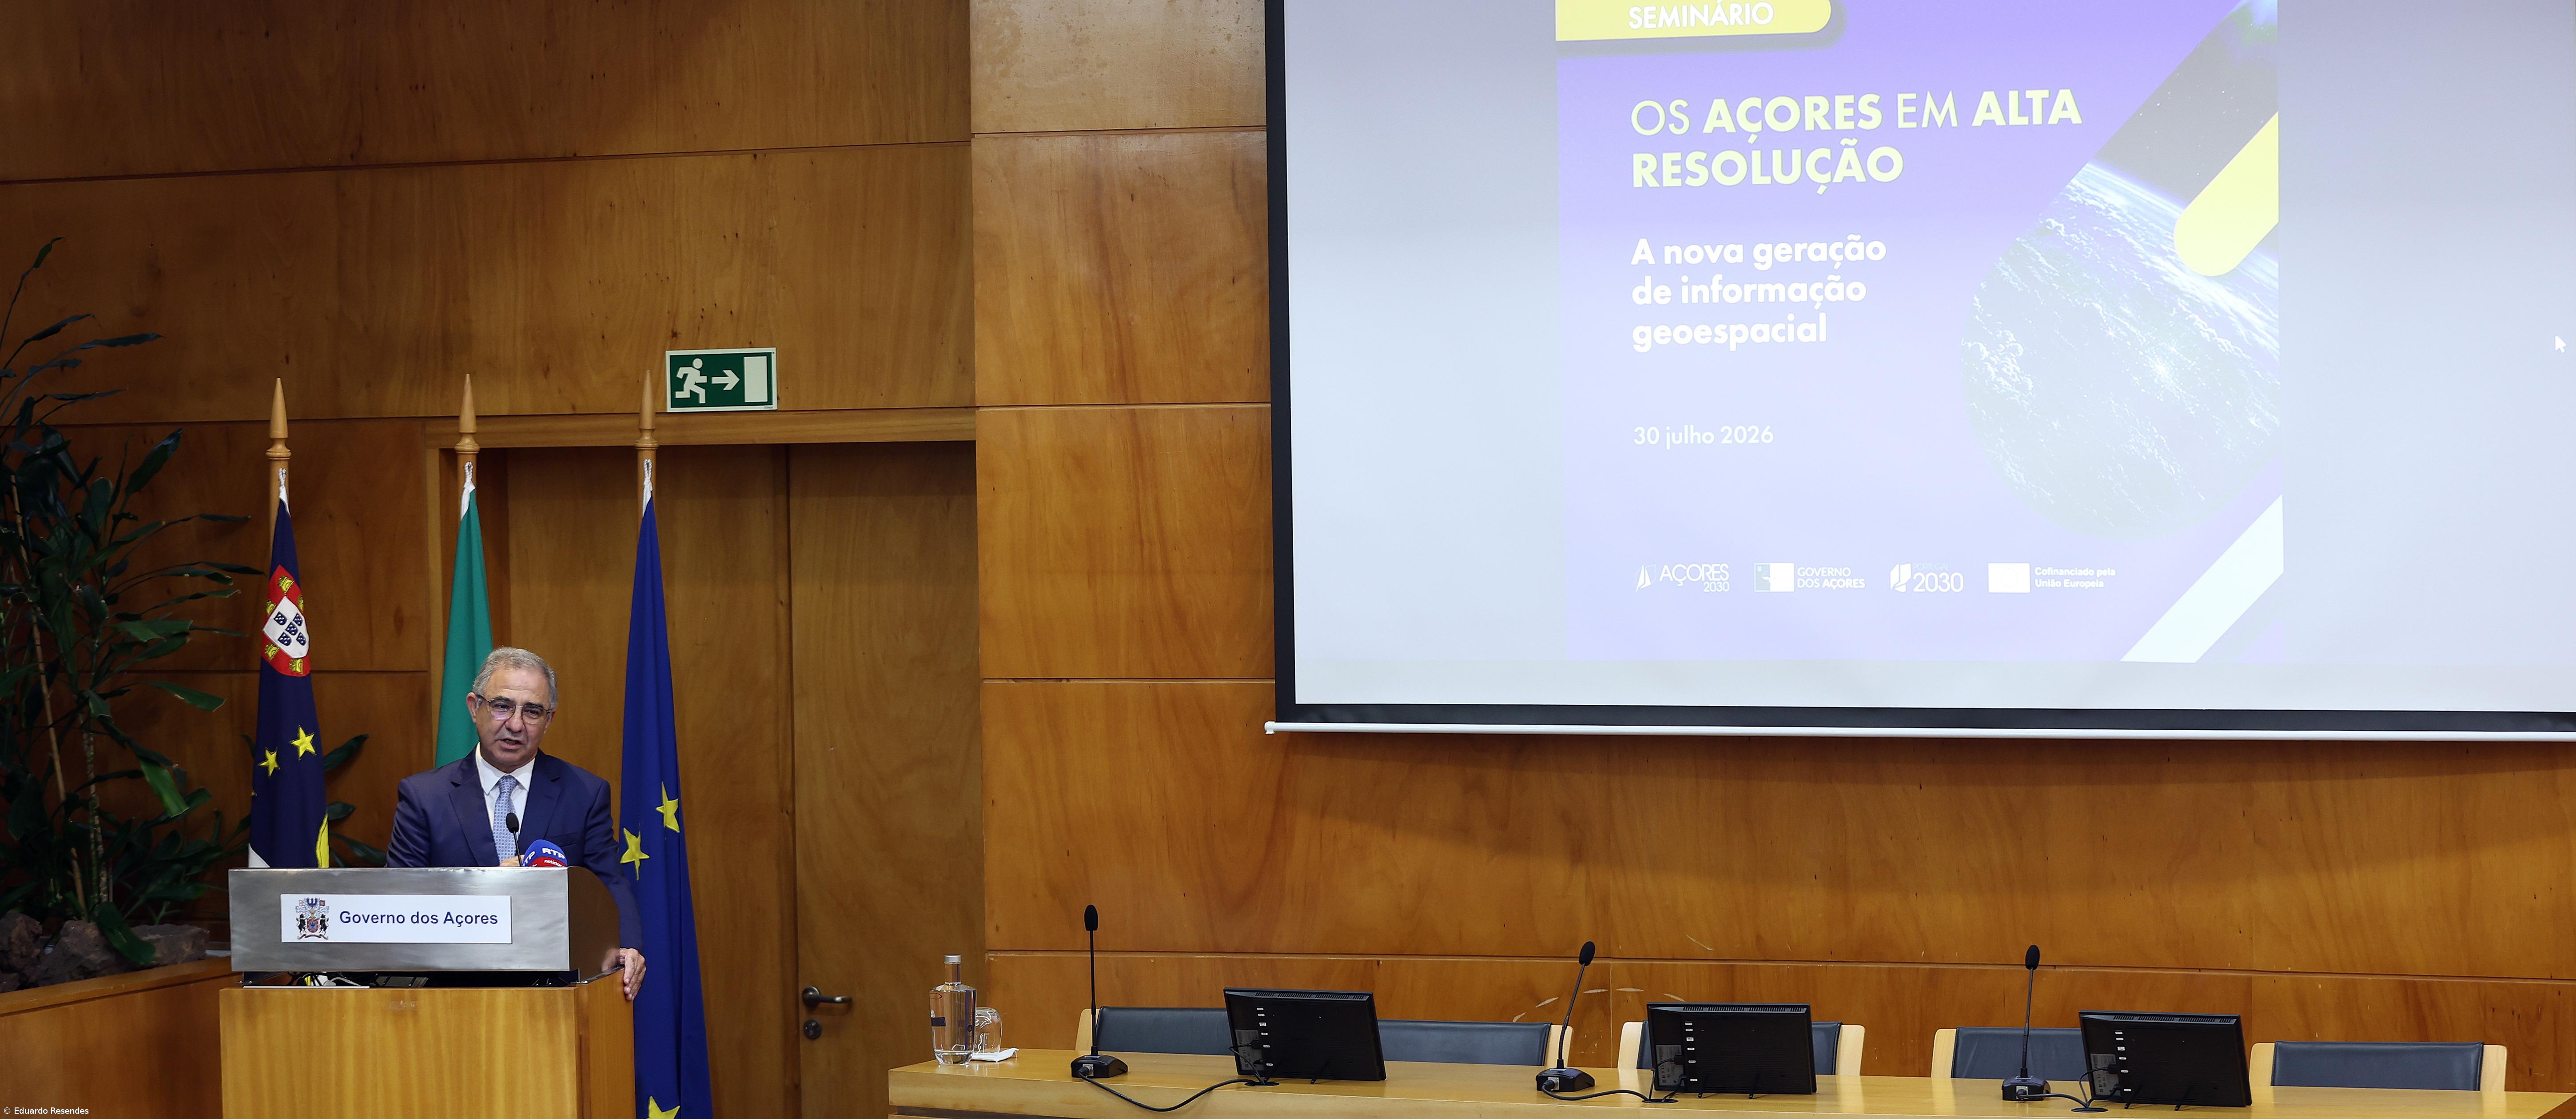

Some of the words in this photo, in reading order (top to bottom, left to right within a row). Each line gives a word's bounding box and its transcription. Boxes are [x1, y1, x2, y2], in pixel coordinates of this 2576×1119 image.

[1629, 0, 1773, 29] SEMINÁRIO
[1632, 100, 1689, 135] OS
[1703, 94, 1882, 144] AÇORES
[1898, 91, 1957, 128] EM
[1972, 89, 2082, 126] ALTA
[1633, 138, 1903, 194] RESOLUÇÃO
[1631, 239, 1655, 264] A
[1664, 244, 1743, 264] nova
[1753, 234, 1886, 270] geração
[1632, 276, 1672, 304] de
[1681, 274, 1866, 310] informação
[1633, 313, 1826, 352] geoespacial
[1634, 427, 1659, 444] 30
[1666, 425, 1714, 449] julho
[1720, 425, 1773, 444] 2026
[1660, 563, 1729, 586] AÇORES
[1797, 567, 1851, 576] GOVERNO
[2035, 567, 2094, 575] Cofinanciado
[2097, 568, 2115, 577] pela
[1704, 582, 1729, 591] 2030
[1798, 579, 1820, 587] DOS
[1822, 579, 1865, 589] AÇORES
[1913, 572, 1963, 592] 2030
[2064, 579, 2103, 589] Europeia
[522, 851, 535, 866] TP
[542, 848, 565, 859] RTP
[340, 911, 405, 923] Governo
[411, 911, 438, 923] dos
[444, 912, 497, 927] Açores
